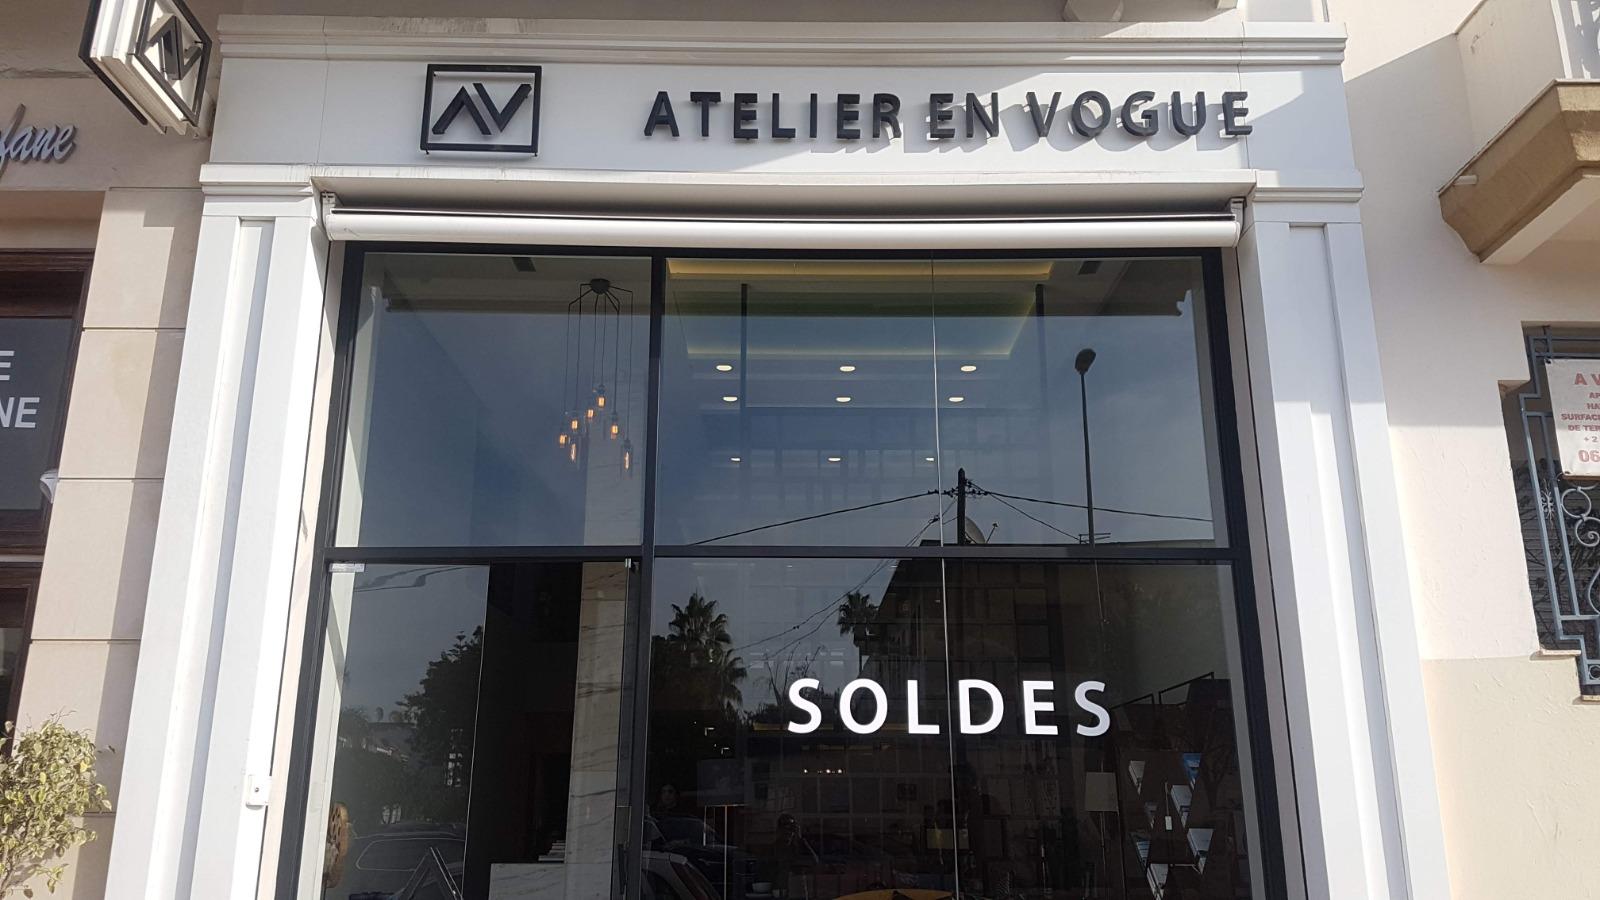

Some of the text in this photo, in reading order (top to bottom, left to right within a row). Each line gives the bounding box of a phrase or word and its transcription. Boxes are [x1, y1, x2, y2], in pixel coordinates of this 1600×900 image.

[644, 90, 1253, 139] ATELIER EN VOGUE
[787, 678, 1111, 737] SOLDES
